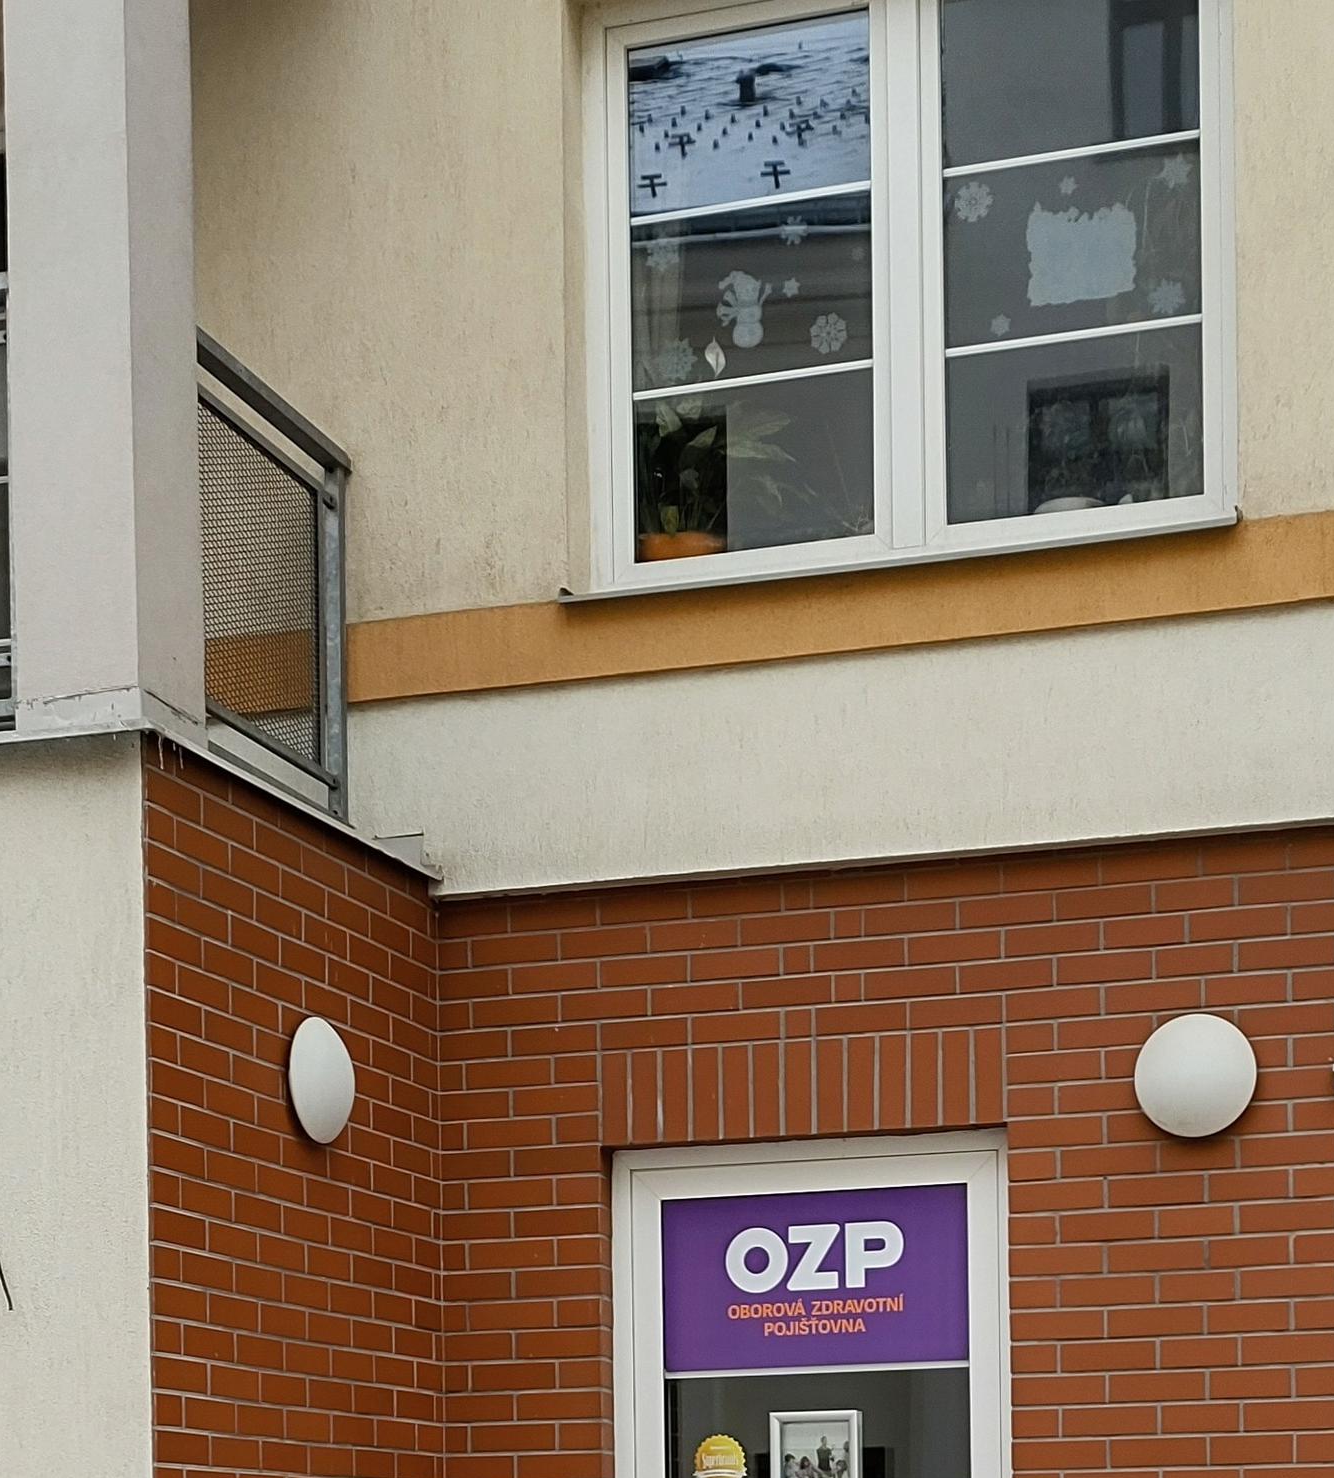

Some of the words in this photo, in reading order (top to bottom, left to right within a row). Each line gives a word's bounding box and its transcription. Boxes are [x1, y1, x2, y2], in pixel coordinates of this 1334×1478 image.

[725, 1220, 905, 1294] OZP
[727, 1298, 806, 1320] OBOROVÁ
[811, 1293, 904, 1316] ZDRAVOTNÍ
[763, 1317, 867, 1337] POJIŠŤOVNA
